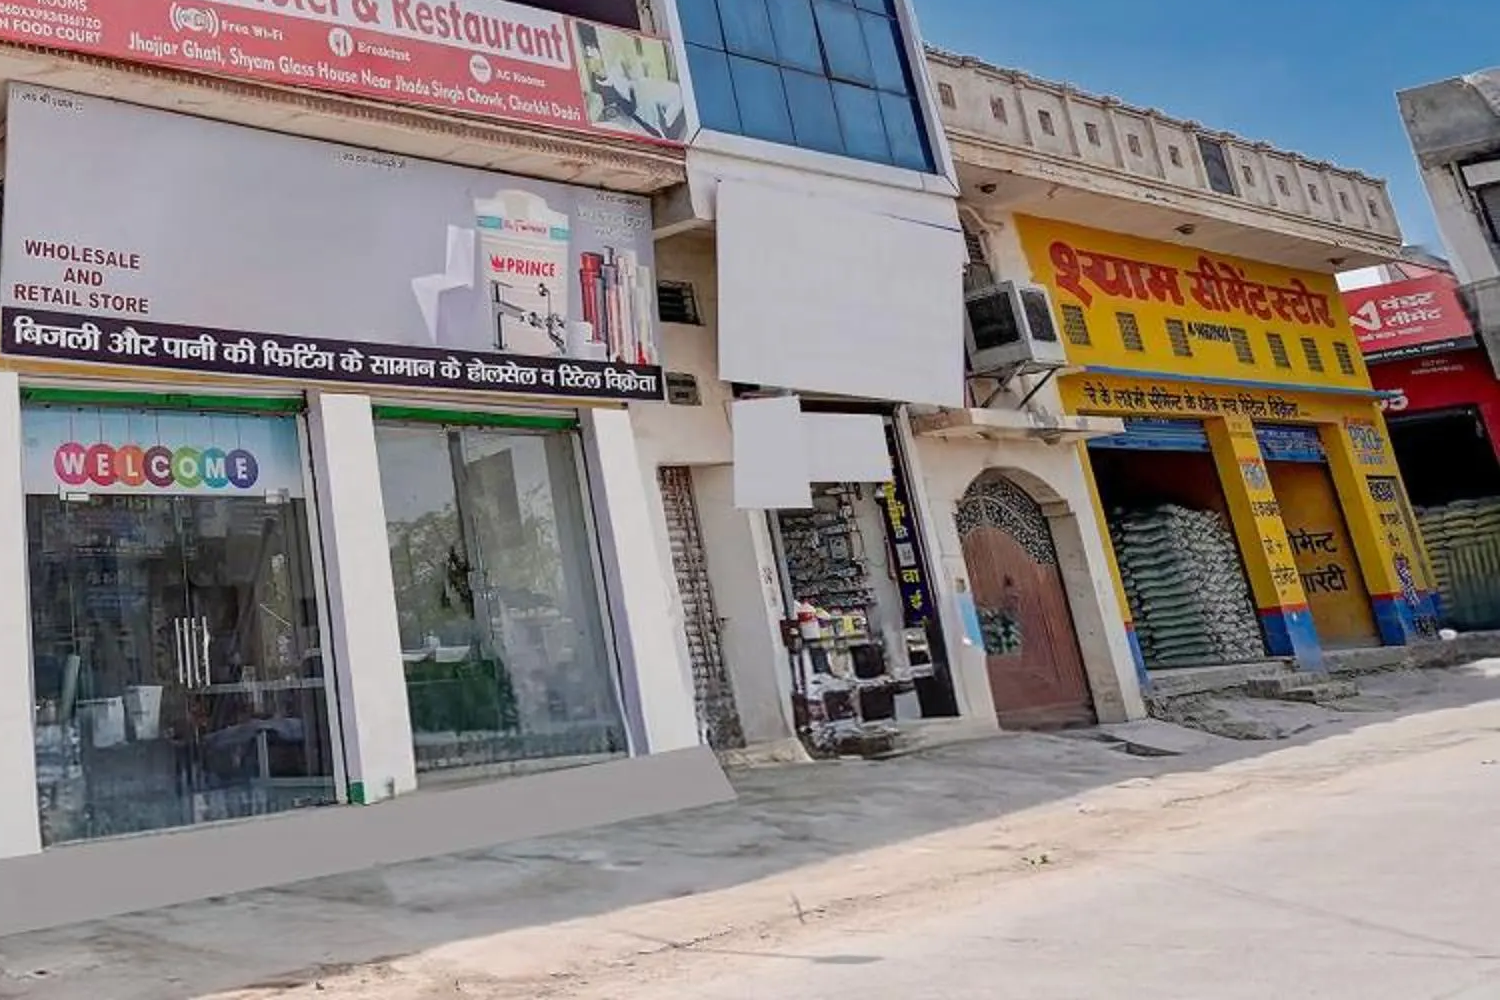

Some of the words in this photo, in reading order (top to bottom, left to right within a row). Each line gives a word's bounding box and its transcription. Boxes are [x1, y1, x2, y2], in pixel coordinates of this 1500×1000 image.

[13, 18, 53, 37] FOOD
[56, 26, 102, 44] COURT
[221, 19, 249, 35] Free
[229, 46, 276, 73] Shyam
[279, 55, 316, 79] Glass
[317, 59, 359, 85] House
[361, 71, 392, 90] Near
[431, 78, 465, 104] Singh
[24, 238, 141, 270] WHOLESALE
[505, 258, 556, 278] PRINCE
[63, 266, 103, 287] AND
[1049, 240, 1185, 310] श्याम
[1265, 277, 1337, 329] स्टोर
[13, 283, 82, 308] RETAIL
[88, 292, 149, 314] STORE
[13, 314, 101, 350] बिजली
[107, 326, 160, 357] और
[162, 333, 218, 362] पानी
[223, 337, 257, 365] की
[262, 340, 334, 372] फिटिंग
[339, 348, 363, 374] के
[369, 352, 436, 379] सामान
[439, 356, 461, 381] के
[466, 358, 538, 385] होलसेल
[540, 366, 556, 387] व
[557, 363, 603, 391] रिटेल
[603, 366, 658, 393] विक्रेता
[60, 451, 249, 481] WELCOME
